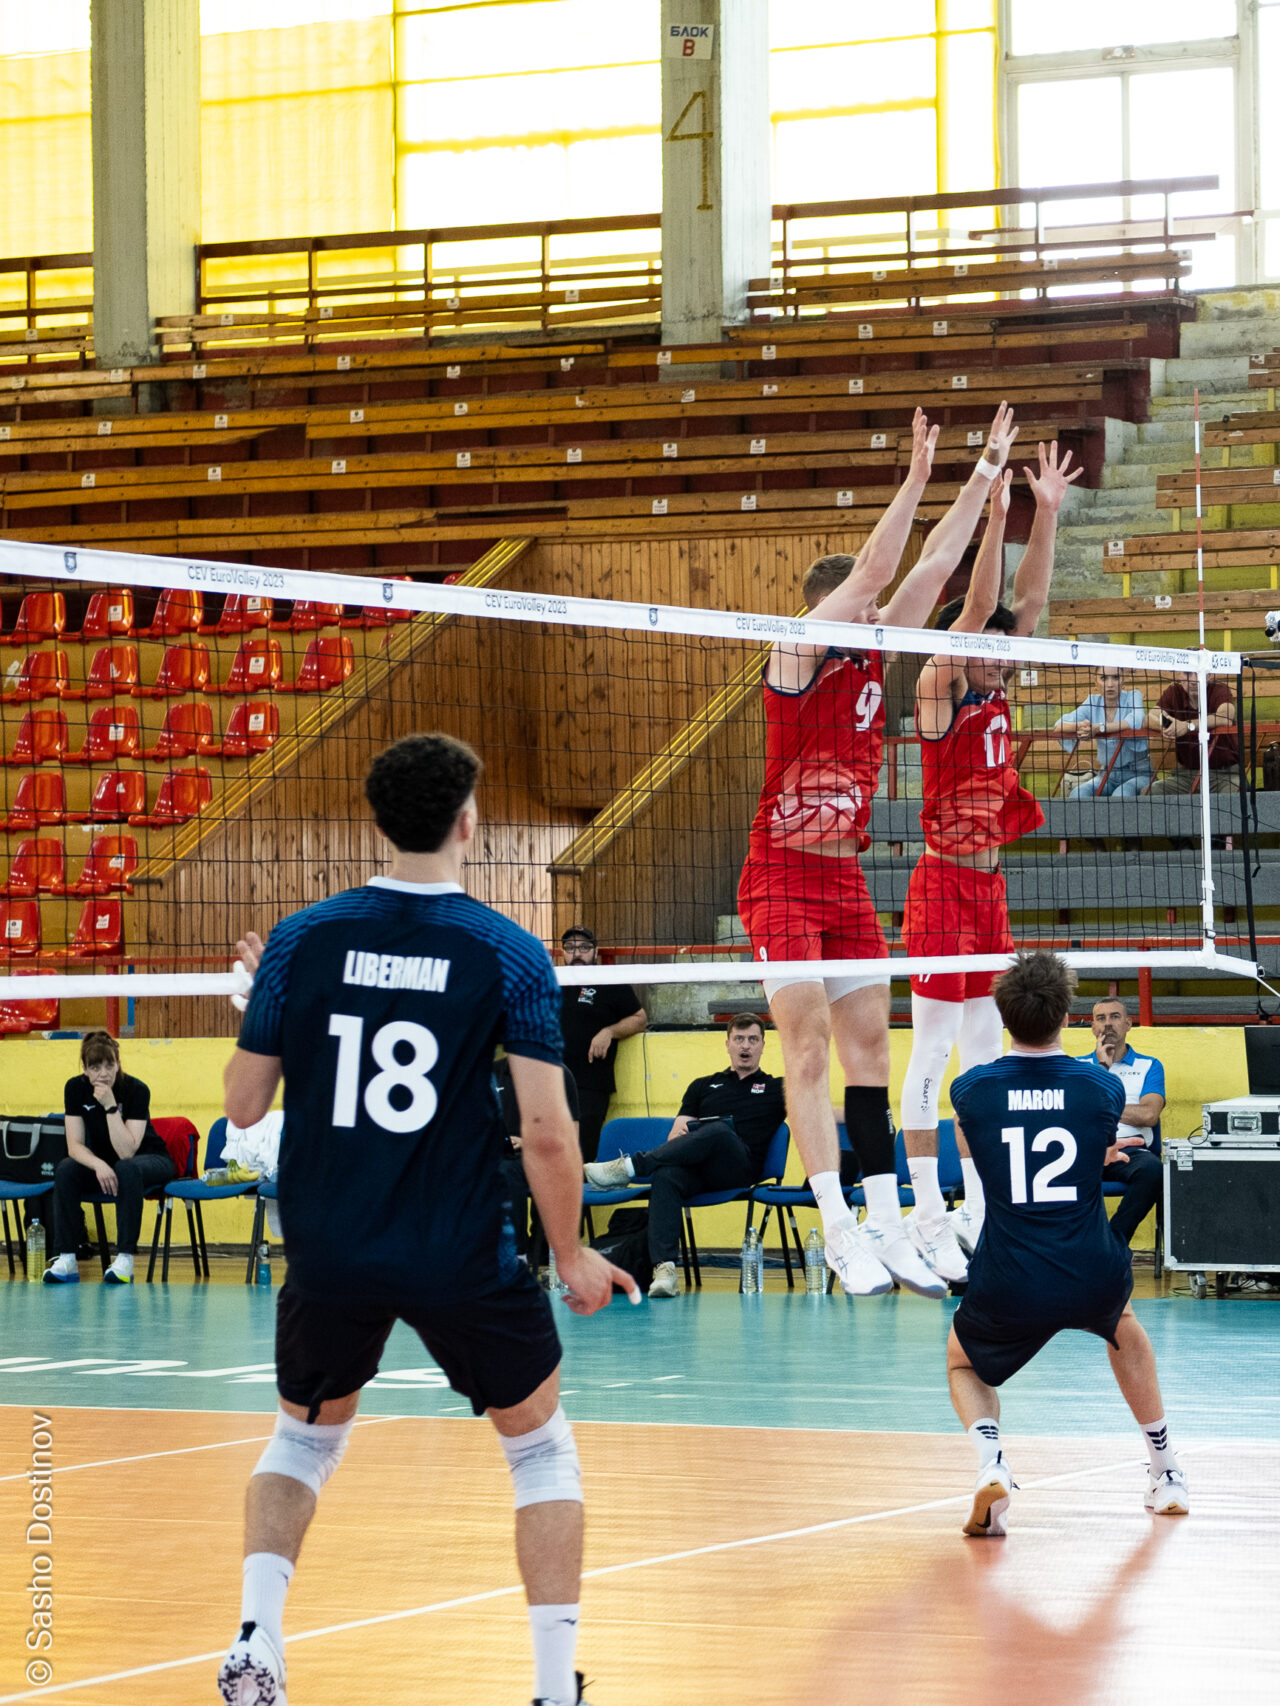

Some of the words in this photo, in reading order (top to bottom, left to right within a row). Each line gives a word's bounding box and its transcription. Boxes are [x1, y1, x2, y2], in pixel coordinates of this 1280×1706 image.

[670, 25, 709, 38] БЛОК
[682, 39, 695, 57] В
[665, 90, 714, 211] 4
[187, 565, 208, 580] CEV
[210, 567, 260, 589] EuroVolley
[262, 572, 285, 588] 2023
[485, 594, 503, 608] CEV
[504, 596, 546, 615] EuroVolley
[548, 600, 567, 614] 2023
[735, 617, 751, 630] CEV
[752, 618, 787, 636] EuroVolley
[789, 622, 806, 635] 2023
[950, 636, 963, 648] CEV
[964, 637, 995, 653] EuroVolley
[996, 639, 1011, 652] 2023
[1135, 650, 1147, 661] CEV
[1219, 658, 1232, 667] CEV
[855, 680, 882, 732] 9
[343, 950, 451, 993] LIBERMAN
[328, 1013, 439, 1134] 18
[923, 1077, 931, 1106] CRAFT
[1007, 1088, 1065, 1111] MARON
[1001, 1126, 1078, 1204] 12
